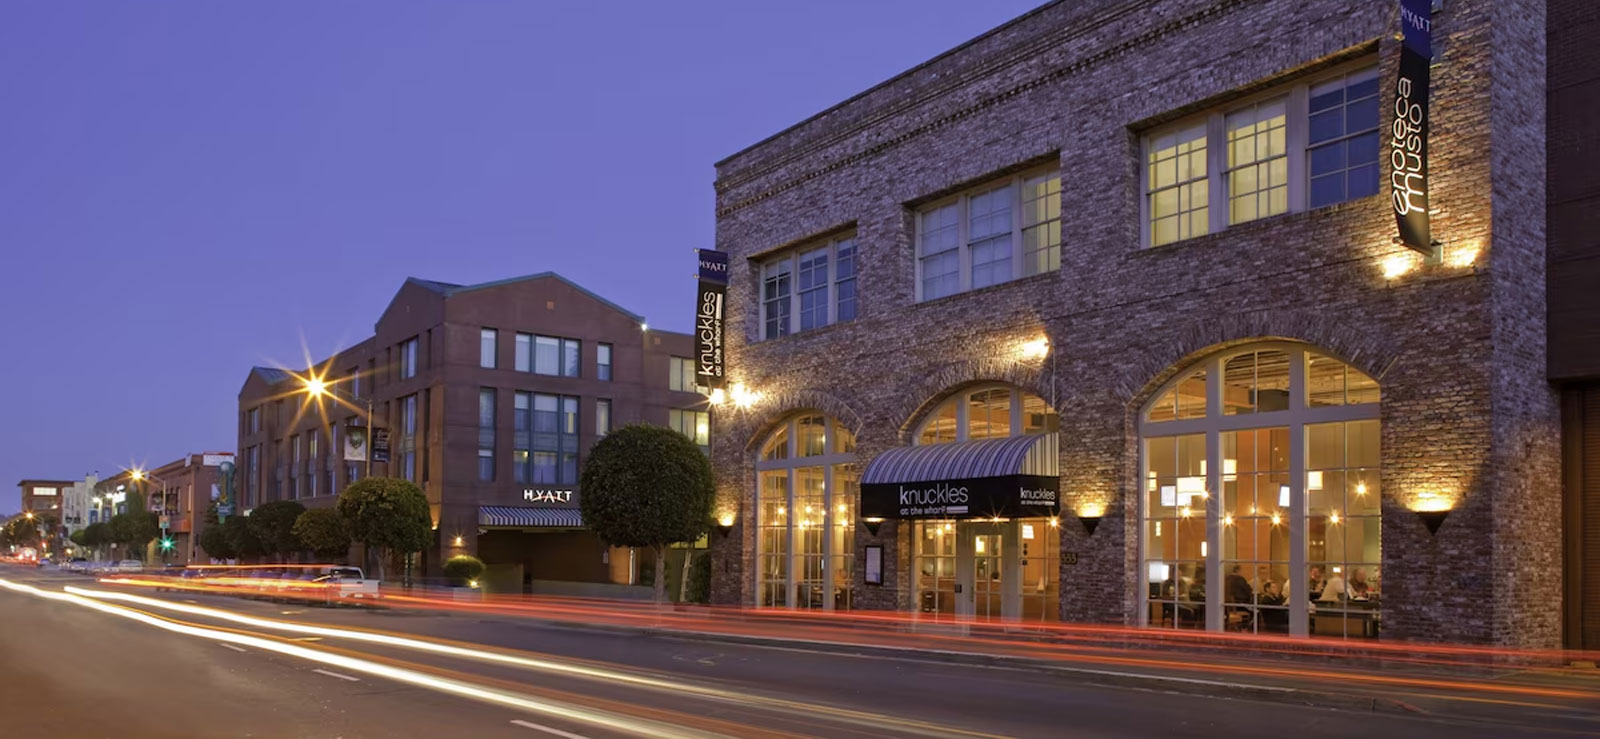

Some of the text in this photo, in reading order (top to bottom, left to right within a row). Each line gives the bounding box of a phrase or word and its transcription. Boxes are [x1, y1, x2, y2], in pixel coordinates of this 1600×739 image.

[1400, 4, 1431, 32] HYATT
[1391, 77, 1412, 215] enoteca
[1404, 103, 1424, 213] musto
[699, 260, 727, 272] HYATT
[697, 291, 716, 376] knuckles
[523, 489, 573, 503] HYATT
[900, 483, 969, 505] knuckles
[1020, 486, 1056, 500] knuckles
